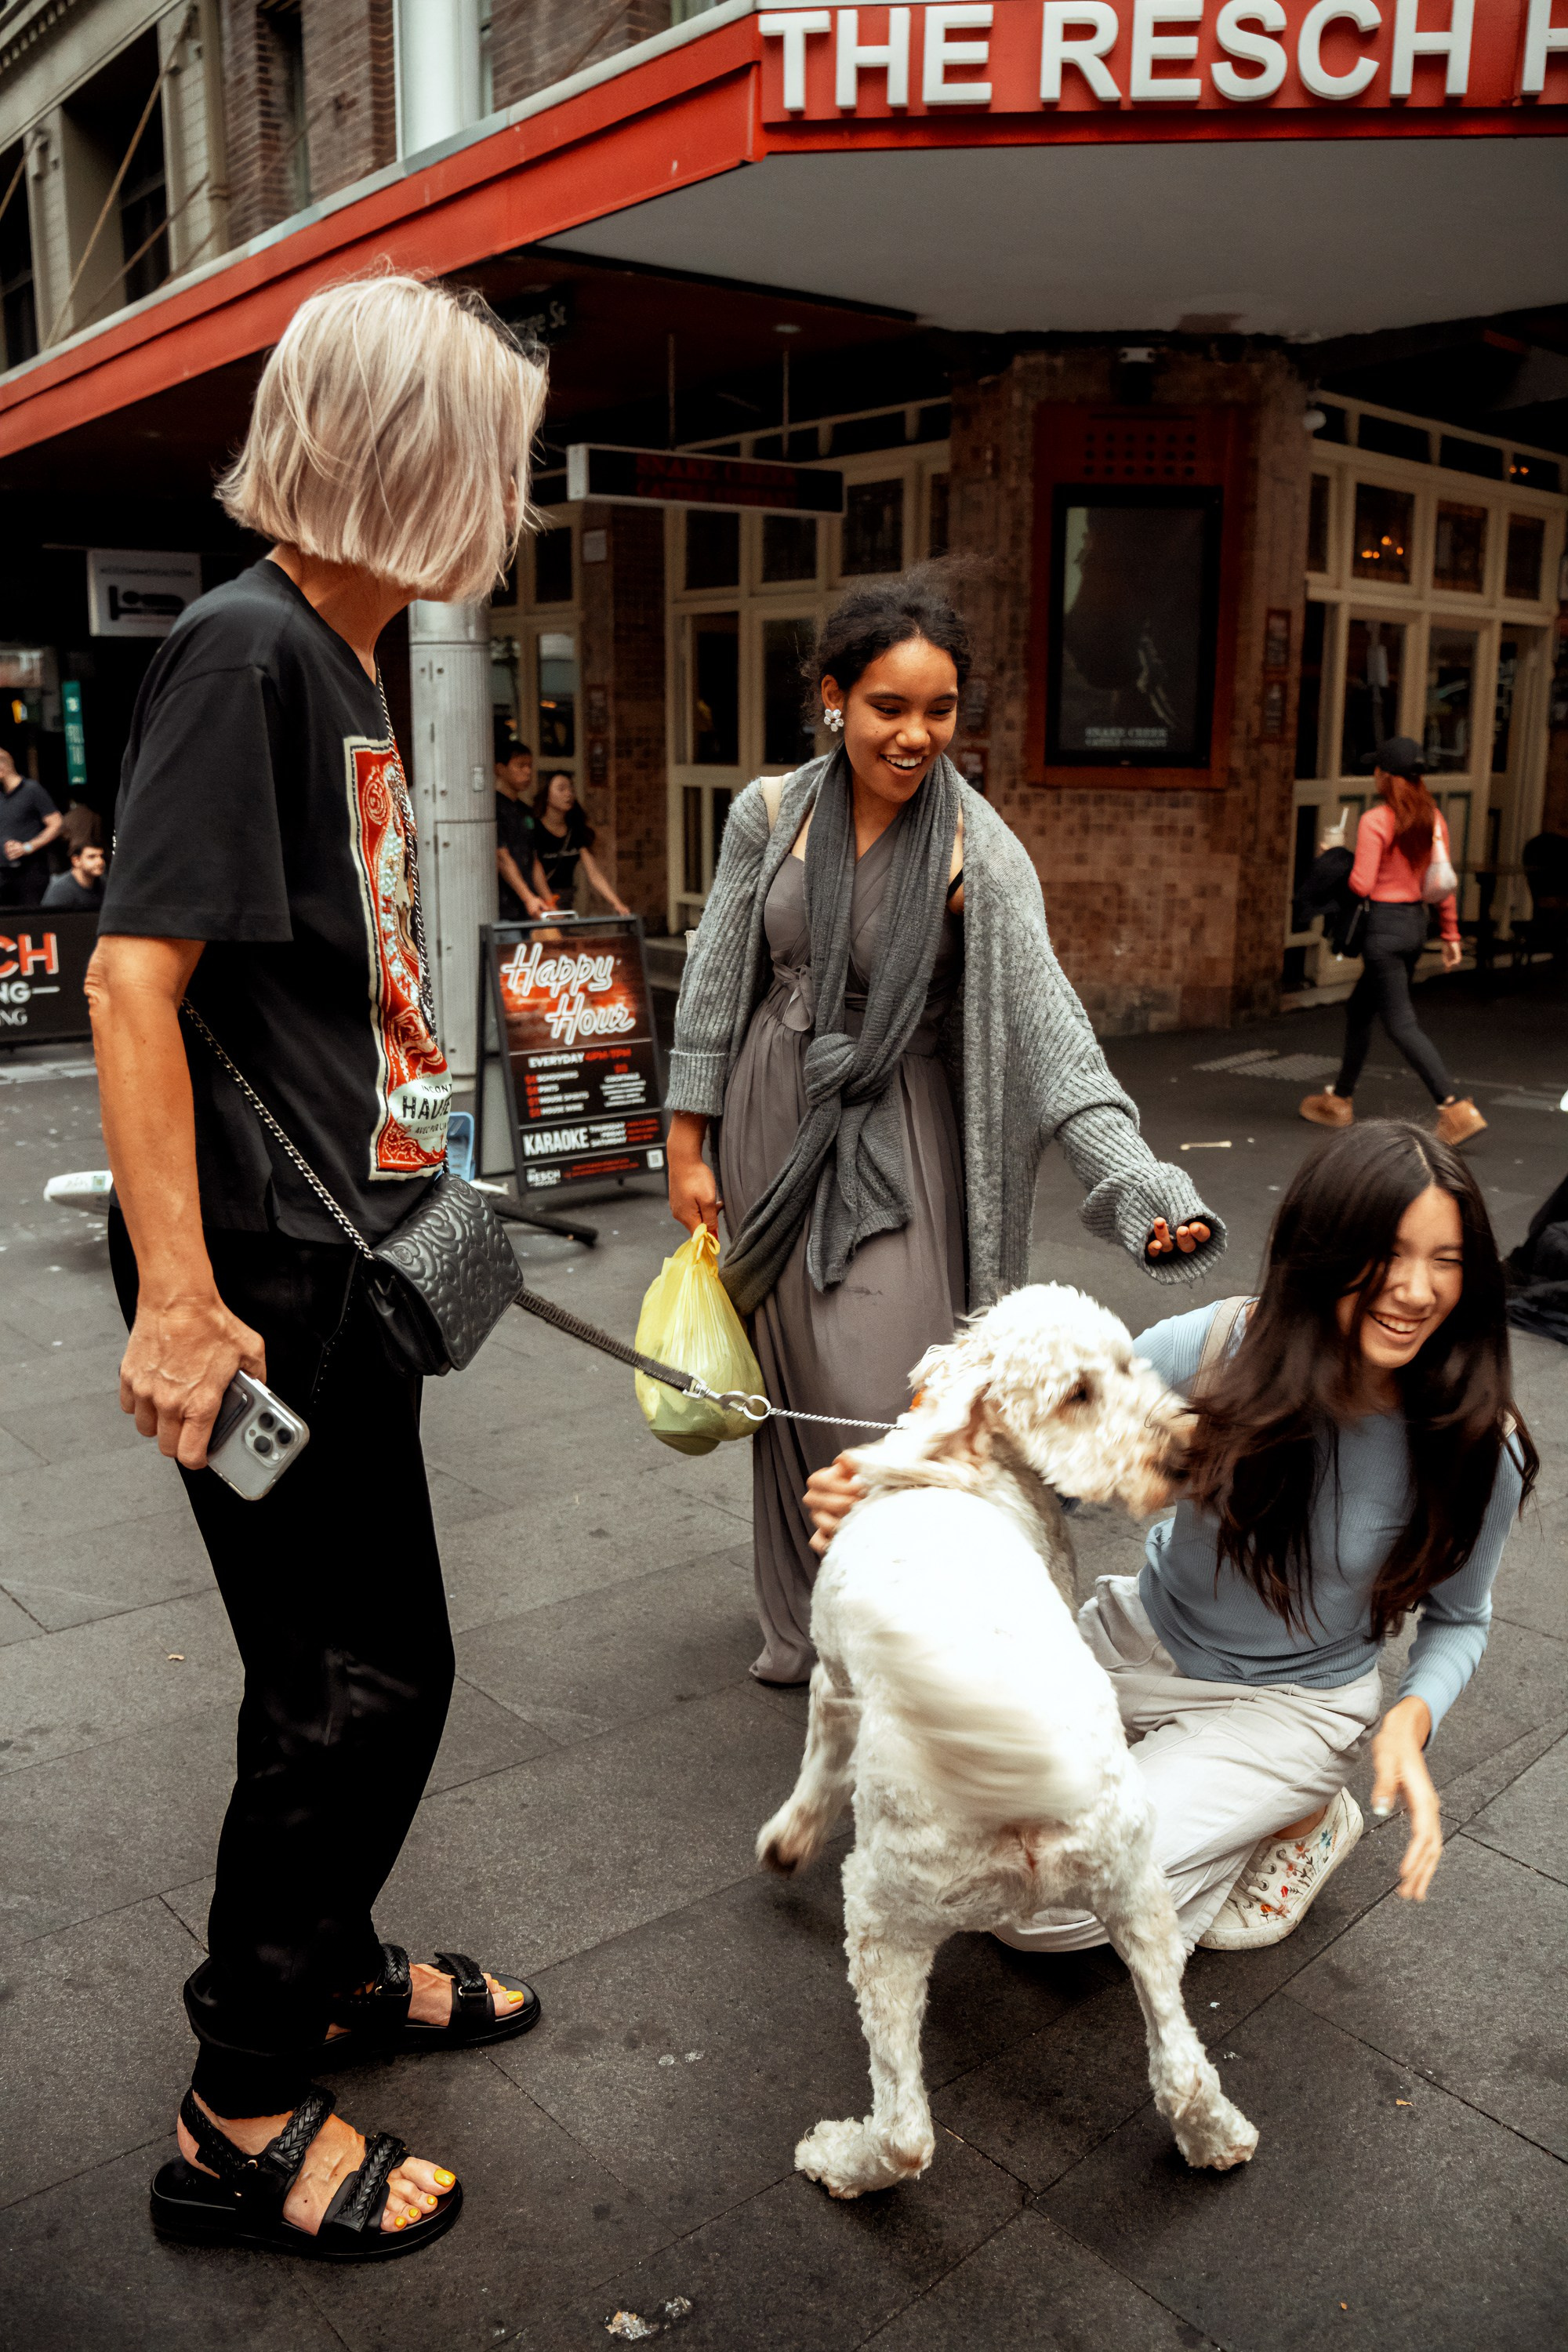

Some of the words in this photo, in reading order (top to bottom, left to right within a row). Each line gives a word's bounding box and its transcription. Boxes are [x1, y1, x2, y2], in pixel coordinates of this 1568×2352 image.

[758, 4, 995, 113] THE
[1039, 0, 1475, 103] RESCH
[500, 942, 615, 998] Happy
[544, 992, 637, 1046] Hour
[528, 1051, 585, 1069] EVERYDAY
[522, 1127, 590, 1156] KARAOKE
